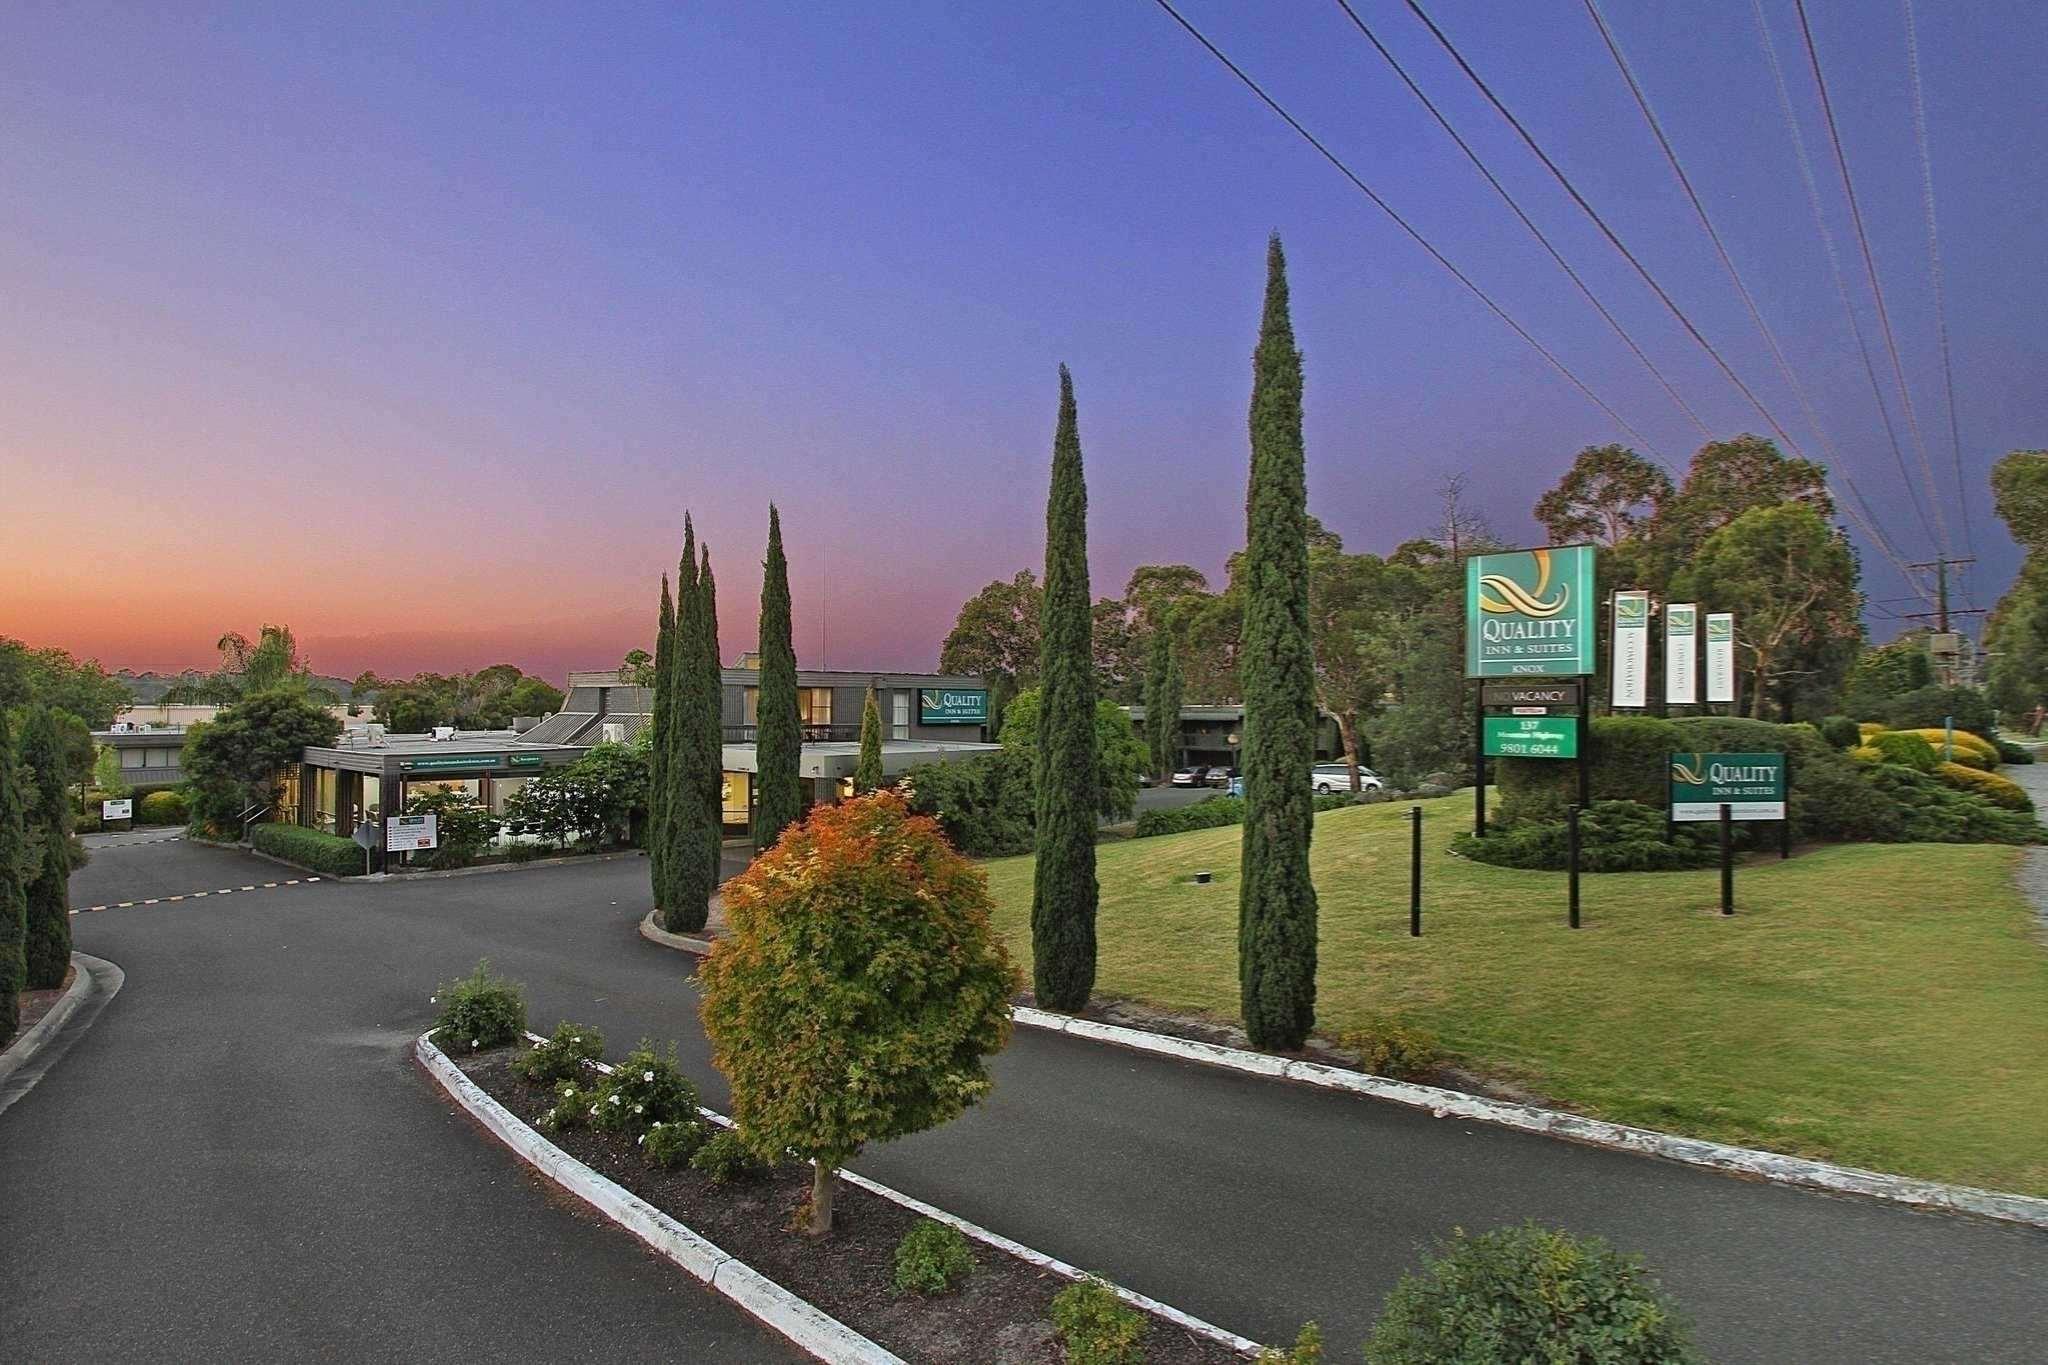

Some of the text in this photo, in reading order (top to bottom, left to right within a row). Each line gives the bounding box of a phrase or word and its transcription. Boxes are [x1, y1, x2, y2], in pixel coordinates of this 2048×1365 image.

[1483, 619, 1576, 643] QUALITY
[1486, 644, 1573, 655] INN & SUITES
[1512, 665, 1544, 673] KNOX
[944, 693, 981, 707] QUALITY
[1511, 691, 1567, 701] VACANCY
[1520, 721, 1539, 730] 137
[1500, 744, 1559, 754] 9801 6044
[1710, 763, 1779, 784] QUALITY
[1712, 787, 1730, 795] INN
[1743, 787, 1775, 795] SUITES
